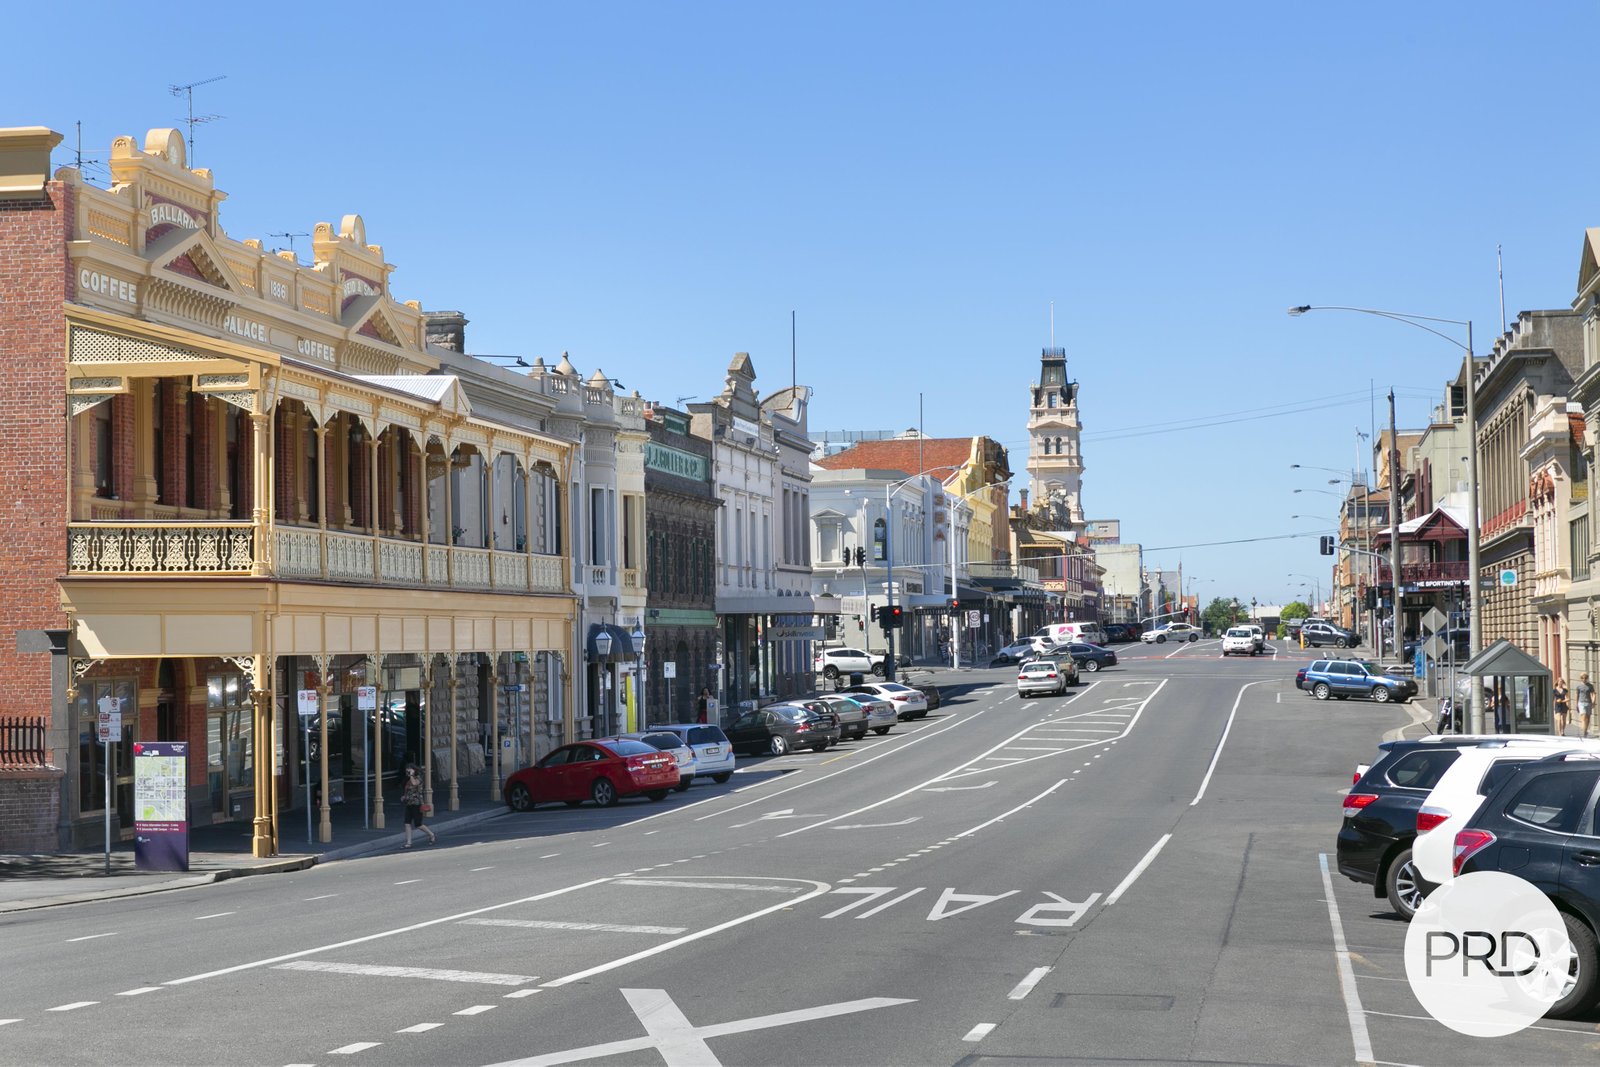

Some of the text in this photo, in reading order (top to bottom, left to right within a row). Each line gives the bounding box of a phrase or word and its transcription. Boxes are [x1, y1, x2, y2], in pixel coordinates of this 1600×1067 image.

[151, 205, 199, 229] BALLARA
[80, 269, 137, 304] COFFEE
[270, 280, 287, 299] 1886
[298, 338, 336, 362] COFFEE
[1425, 579, 1454, 588] SPORTING
[821, 887, 1103, 927] RAIL
